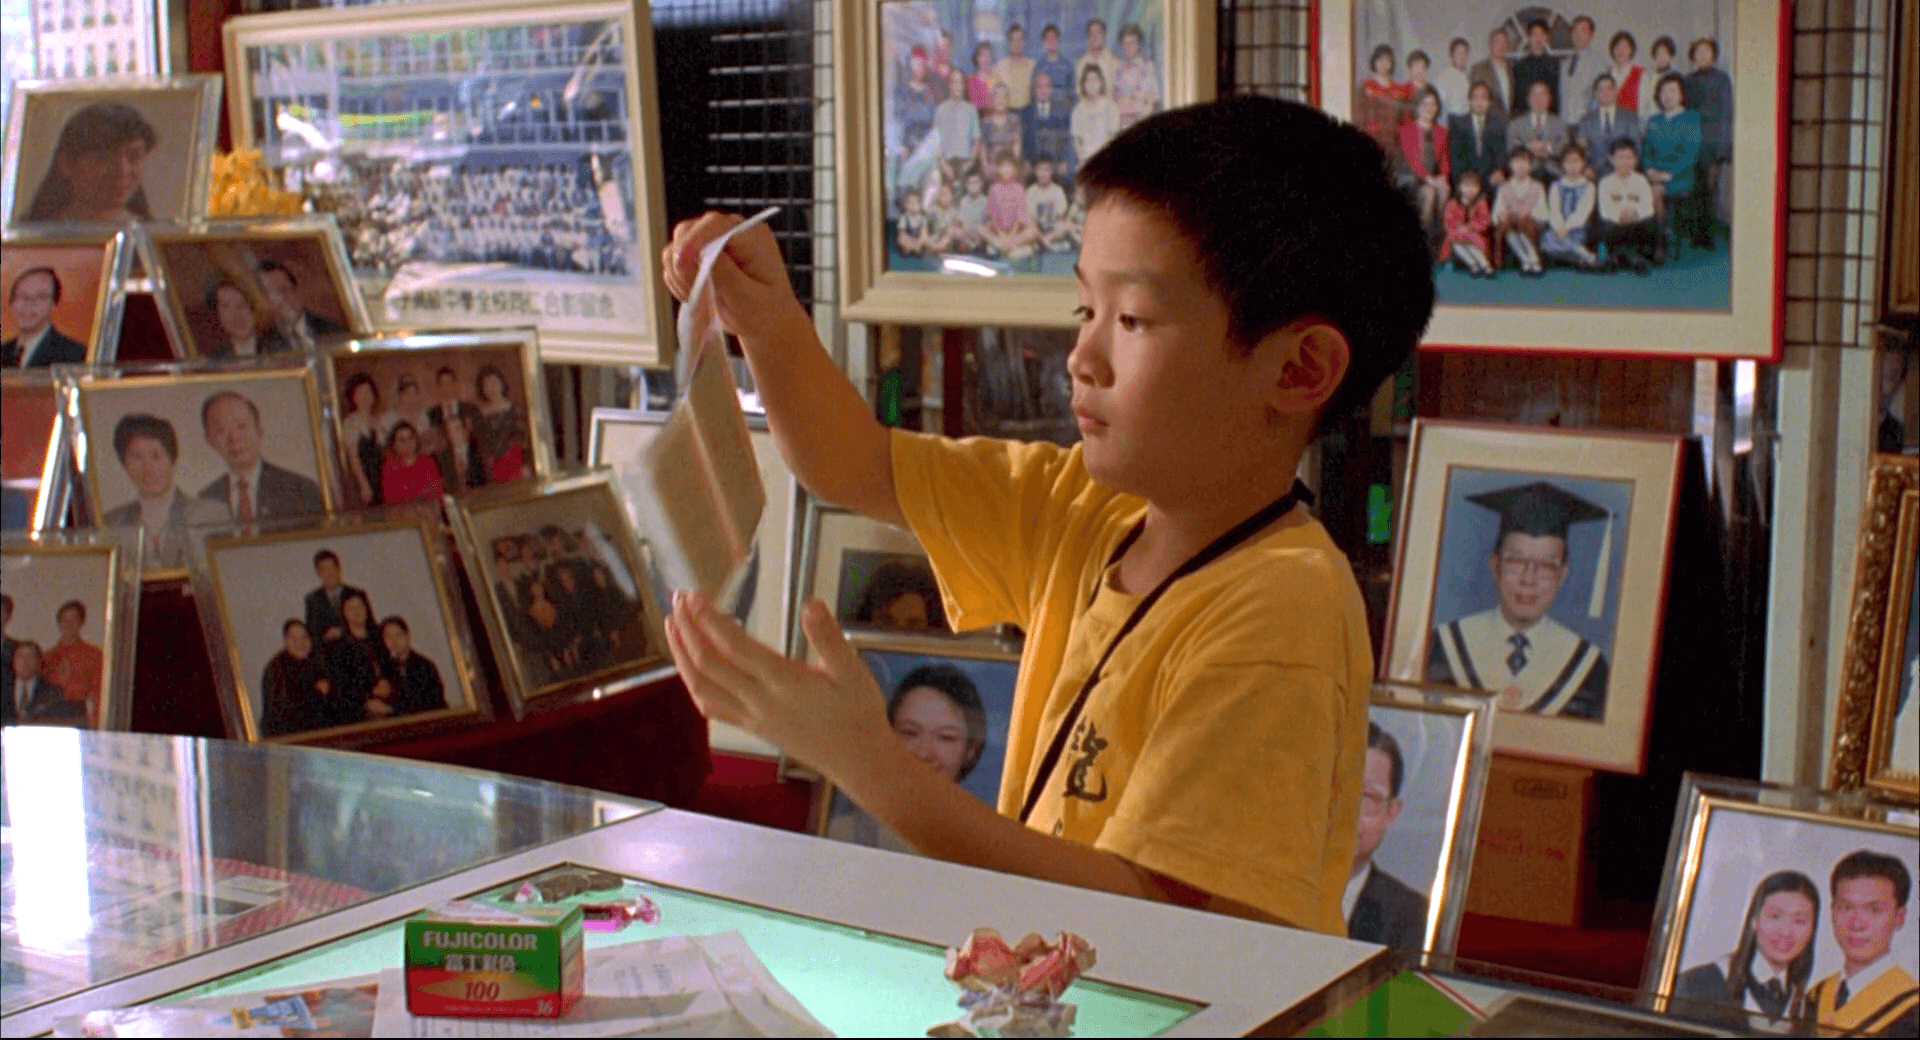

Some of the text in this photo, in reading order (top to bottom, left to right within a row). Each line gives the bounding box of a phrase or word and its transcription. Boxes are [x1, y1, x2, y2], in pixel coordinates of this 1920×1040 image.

[423, 930, 538, 951] FUJICOLOR
[464, 981, 500, 1000] 100
[536, 999, 554, 1015] 36
